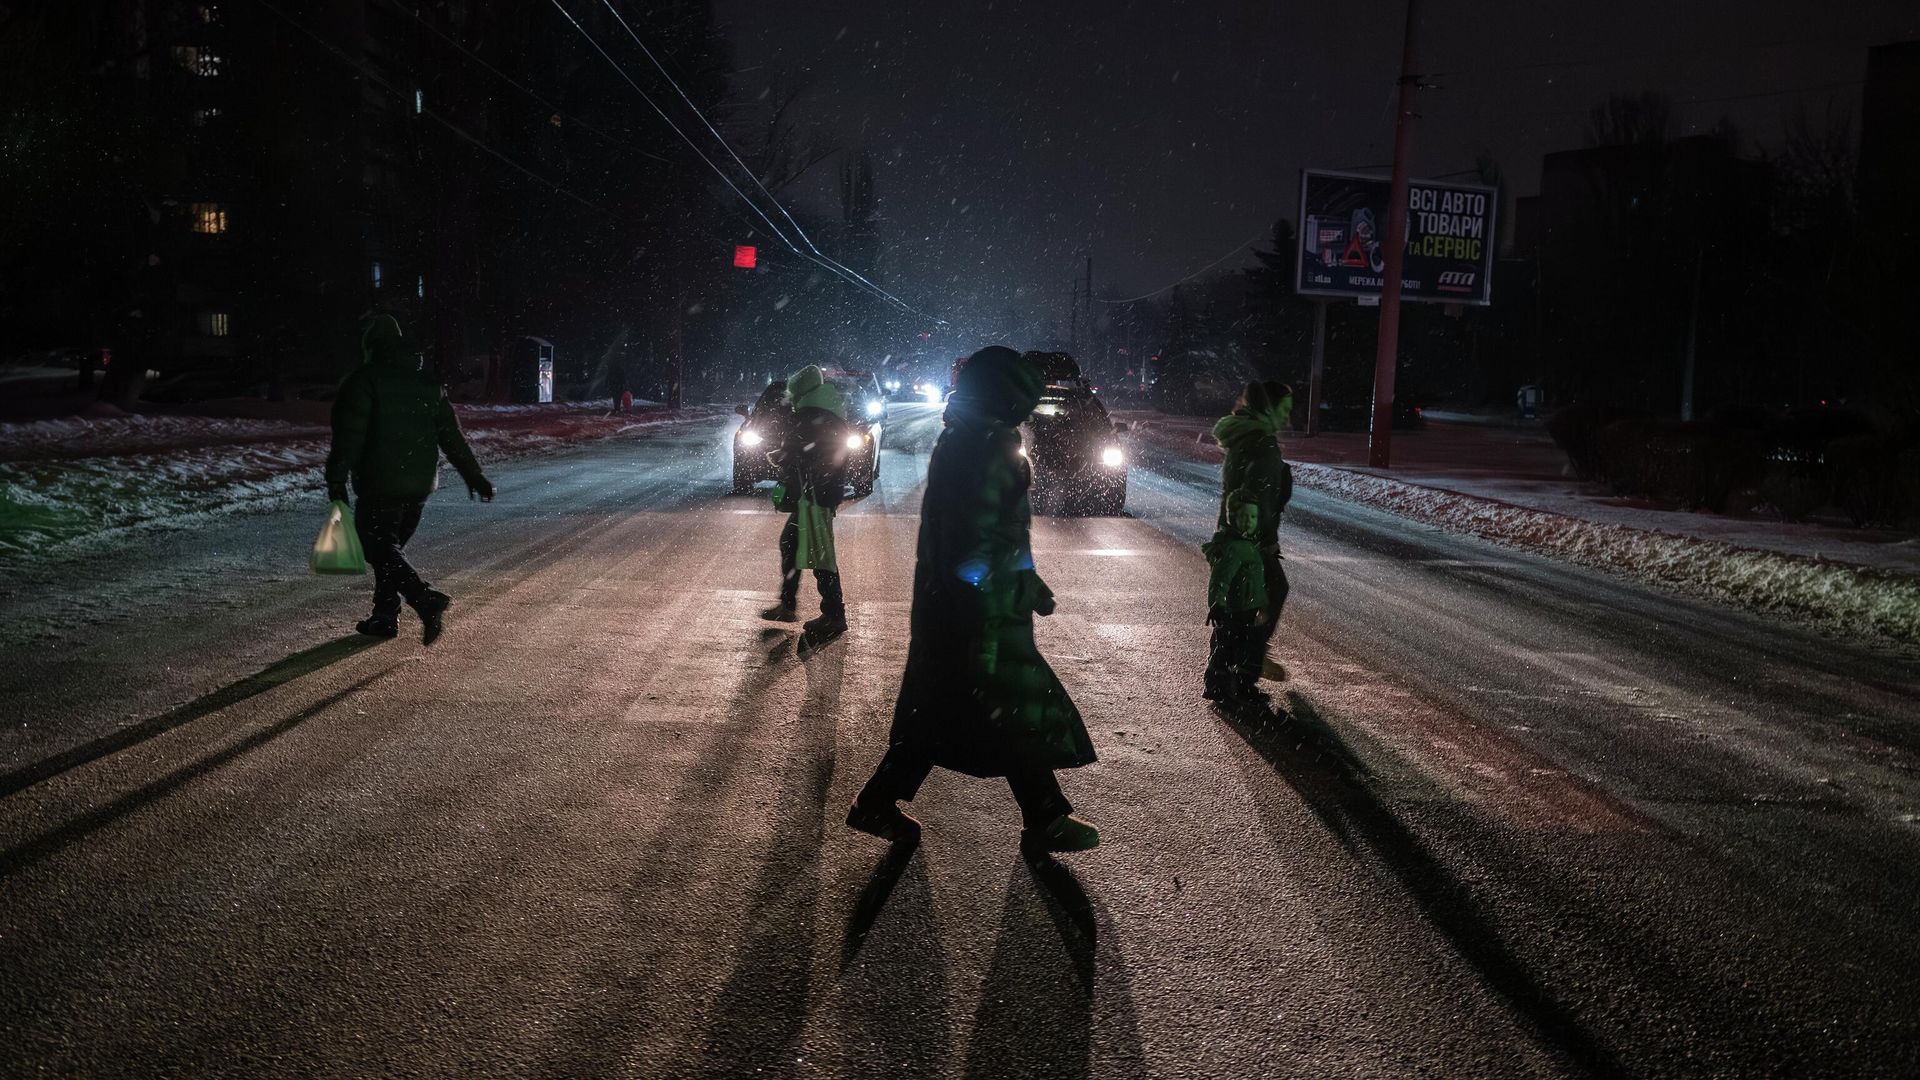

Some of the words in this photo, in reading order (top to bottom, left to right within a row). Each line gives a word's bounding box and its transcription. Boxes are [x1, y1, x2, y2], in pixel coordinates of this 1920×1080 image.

[1409, 187, 1438, 212] ВСІ
[1441, 191, 1486, 217] АВТО
[1417, 211, 1484, 239] ТОВАРИ
[1422, 234, 1482, 261] СЕРВІС
